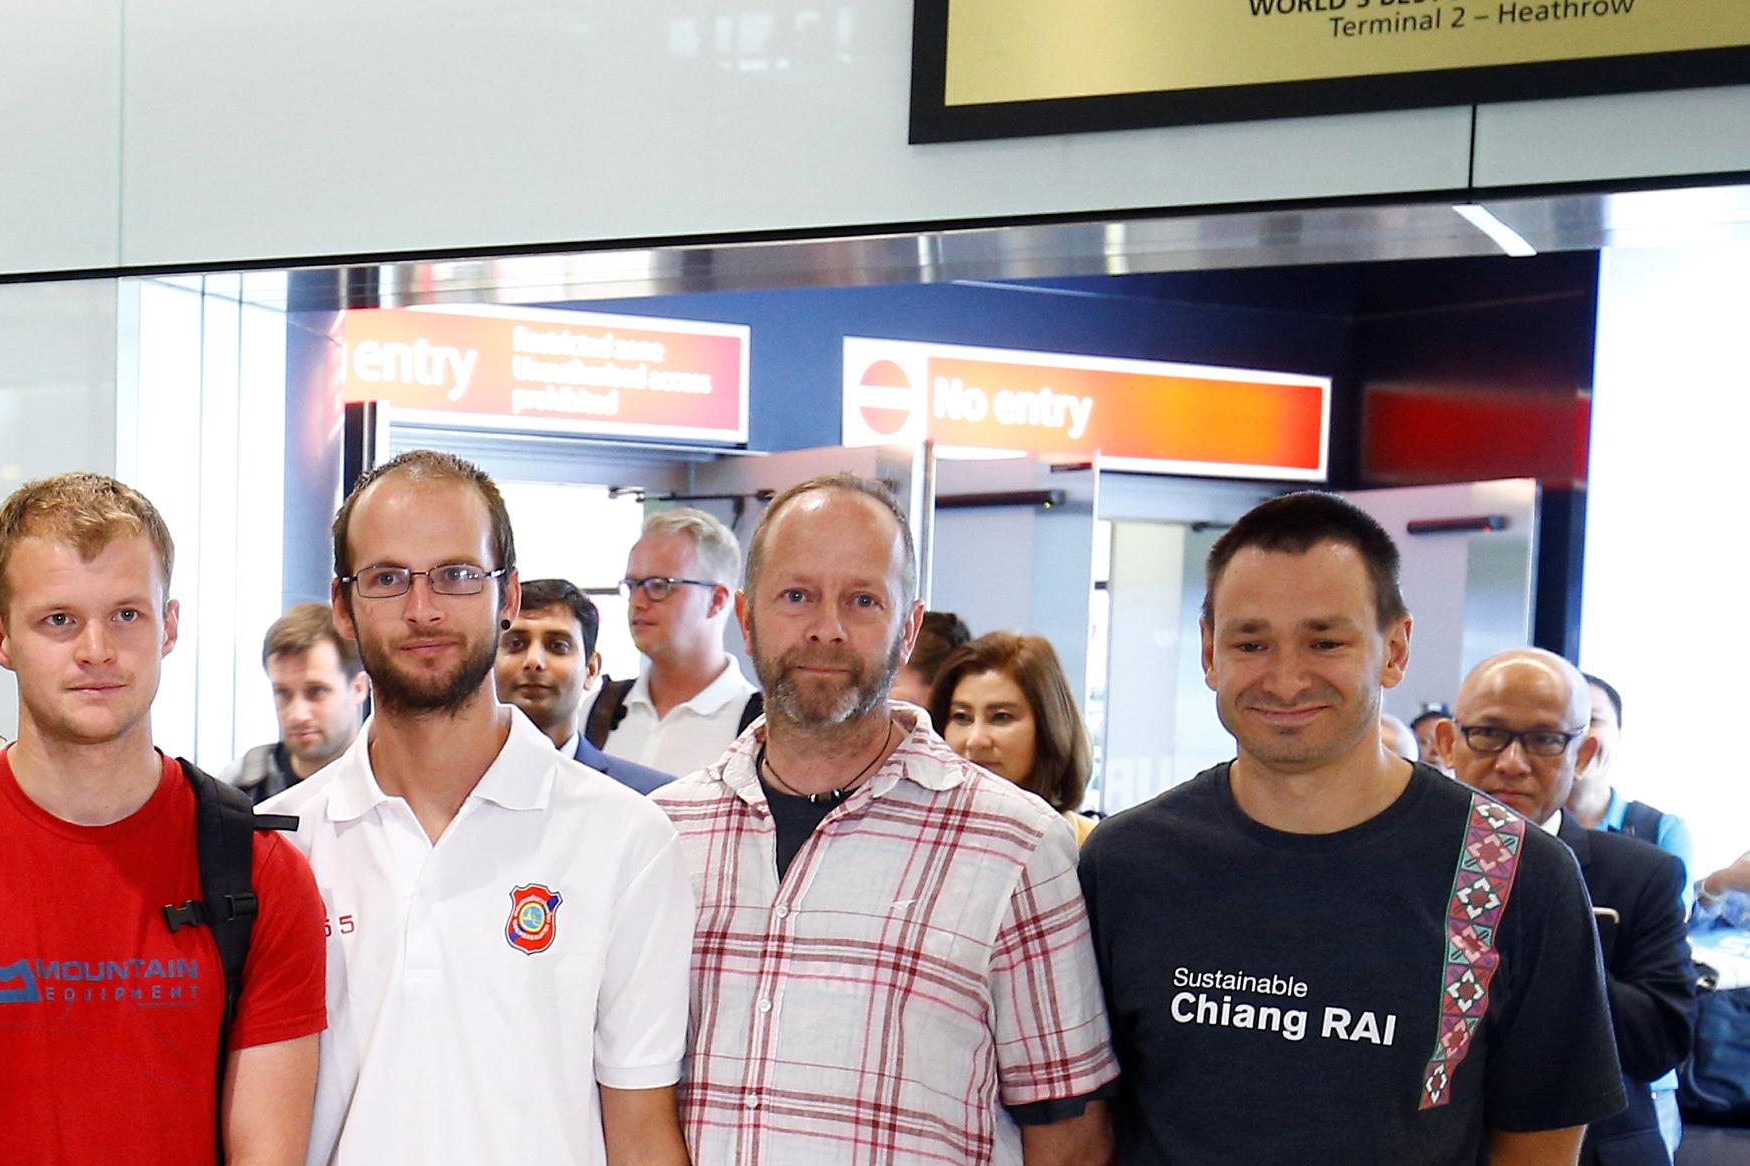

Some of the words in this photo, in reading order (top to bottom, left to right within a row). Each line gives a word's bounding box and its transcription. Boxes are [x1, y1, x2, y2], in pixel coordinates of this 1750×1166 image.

[1329, 8, 1441, 37] Terminal
[1451, 7, 1465, 28] 2
[1498, 0, 1635, 25] Heathrow
[352, 337, 478, 401] entry
[933, 376, 987, 422] No
[992, 384, 1093, 439] entry
[35, 958, 199, 981] MOUNTAIN
[1173, 967, 1308, 998] Sustainable
[1170, 991, 1308, 1041] Chiang
[1321, 1006, 1397, 1046] RAI
